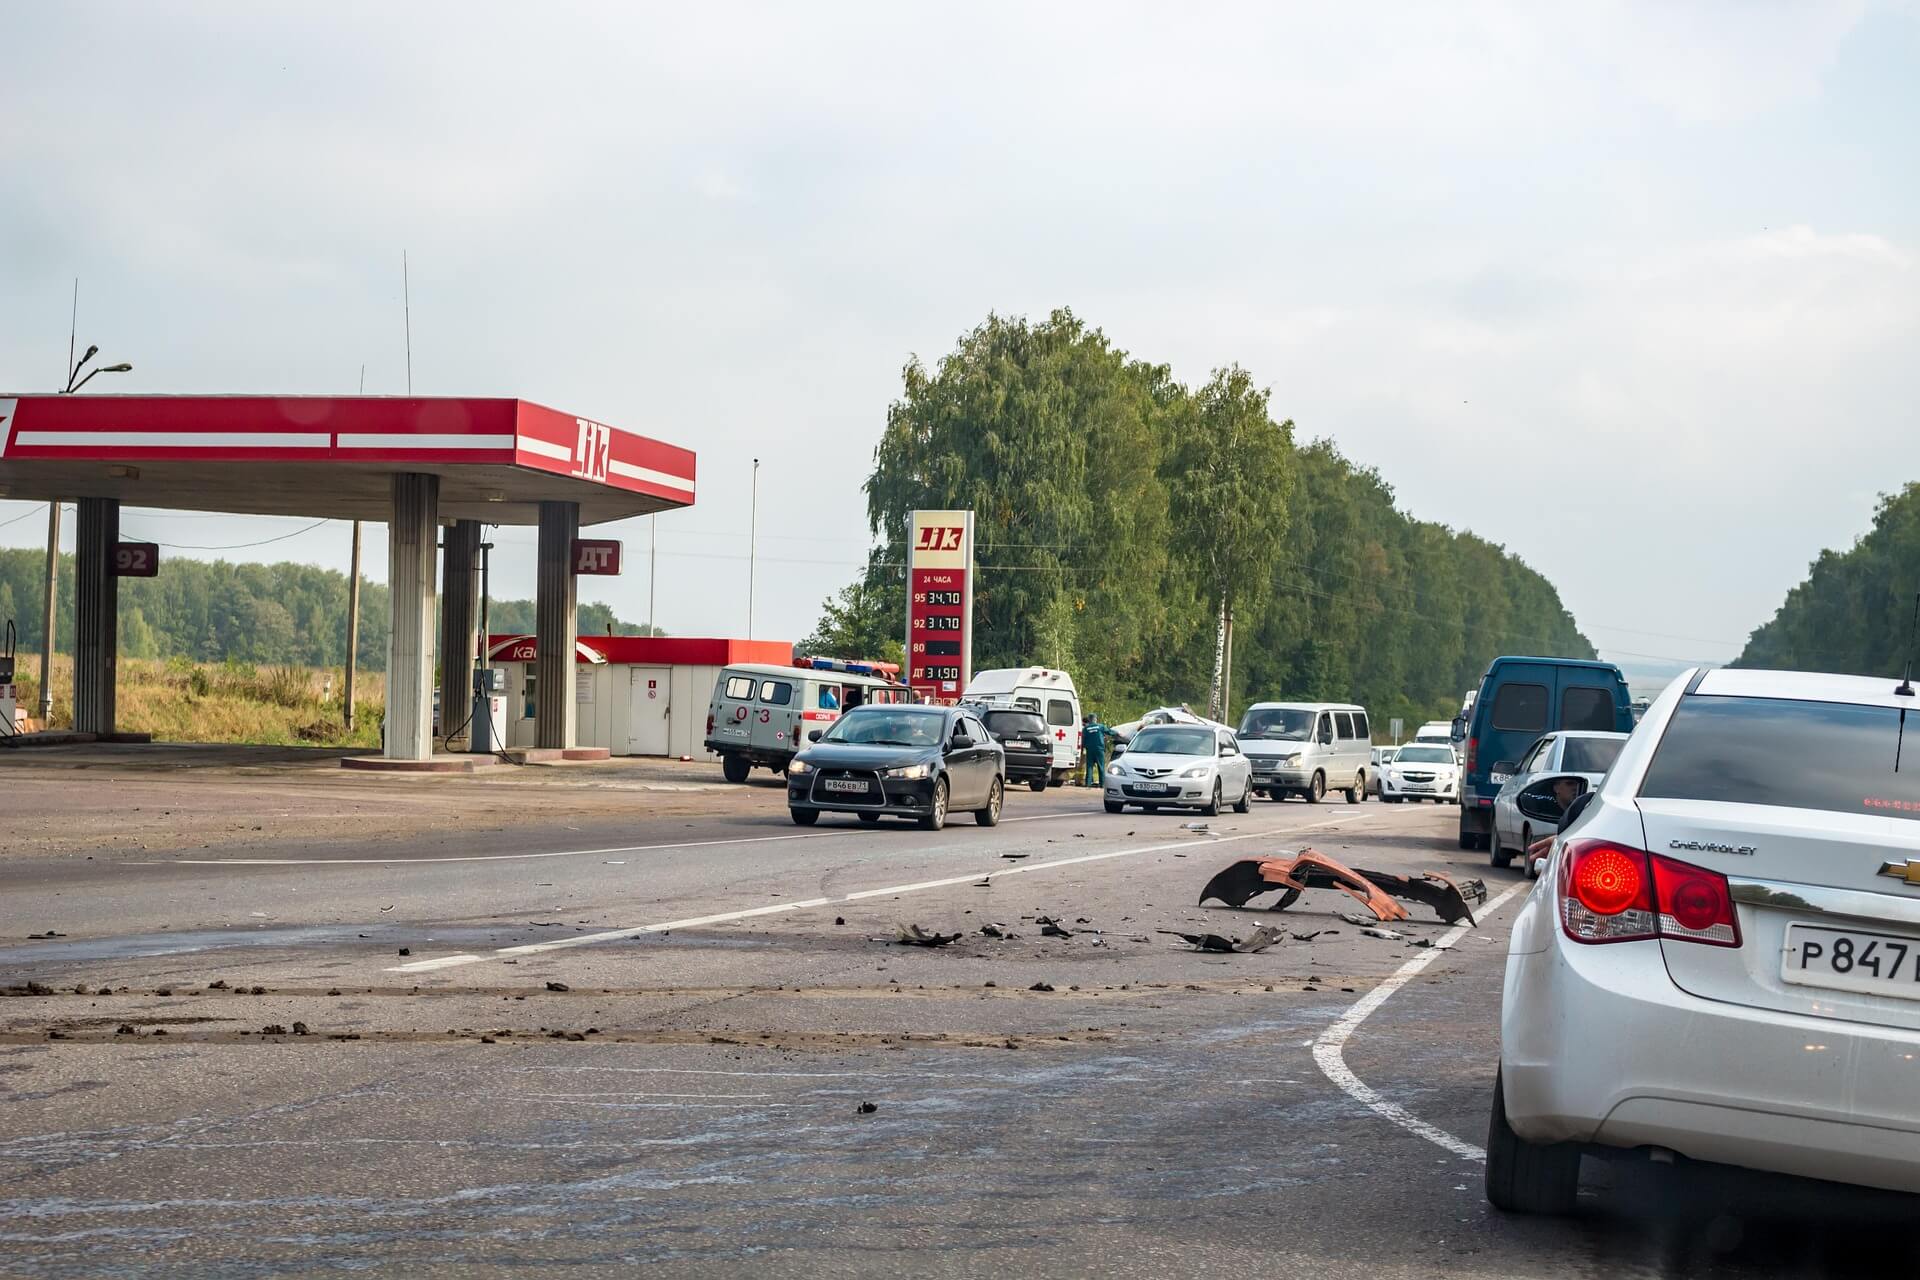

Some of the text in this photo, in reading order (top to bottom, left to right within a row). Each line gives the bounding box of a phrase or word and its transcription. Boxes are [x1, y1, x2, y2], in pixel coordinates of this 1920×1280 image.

[116, 550, 147, 569] 92
[578, 547, 613, 571] ДТ
[923, 575, 952, 584] 24 ЧАСА
[914, 593, 926, 603] 95
[914, 619, 926, 629] 92
[913, 643, 925, 653] 80
[912, 668, 924, 679] ДТ
[1669, 839, 1758, 857] CHEVROLET
